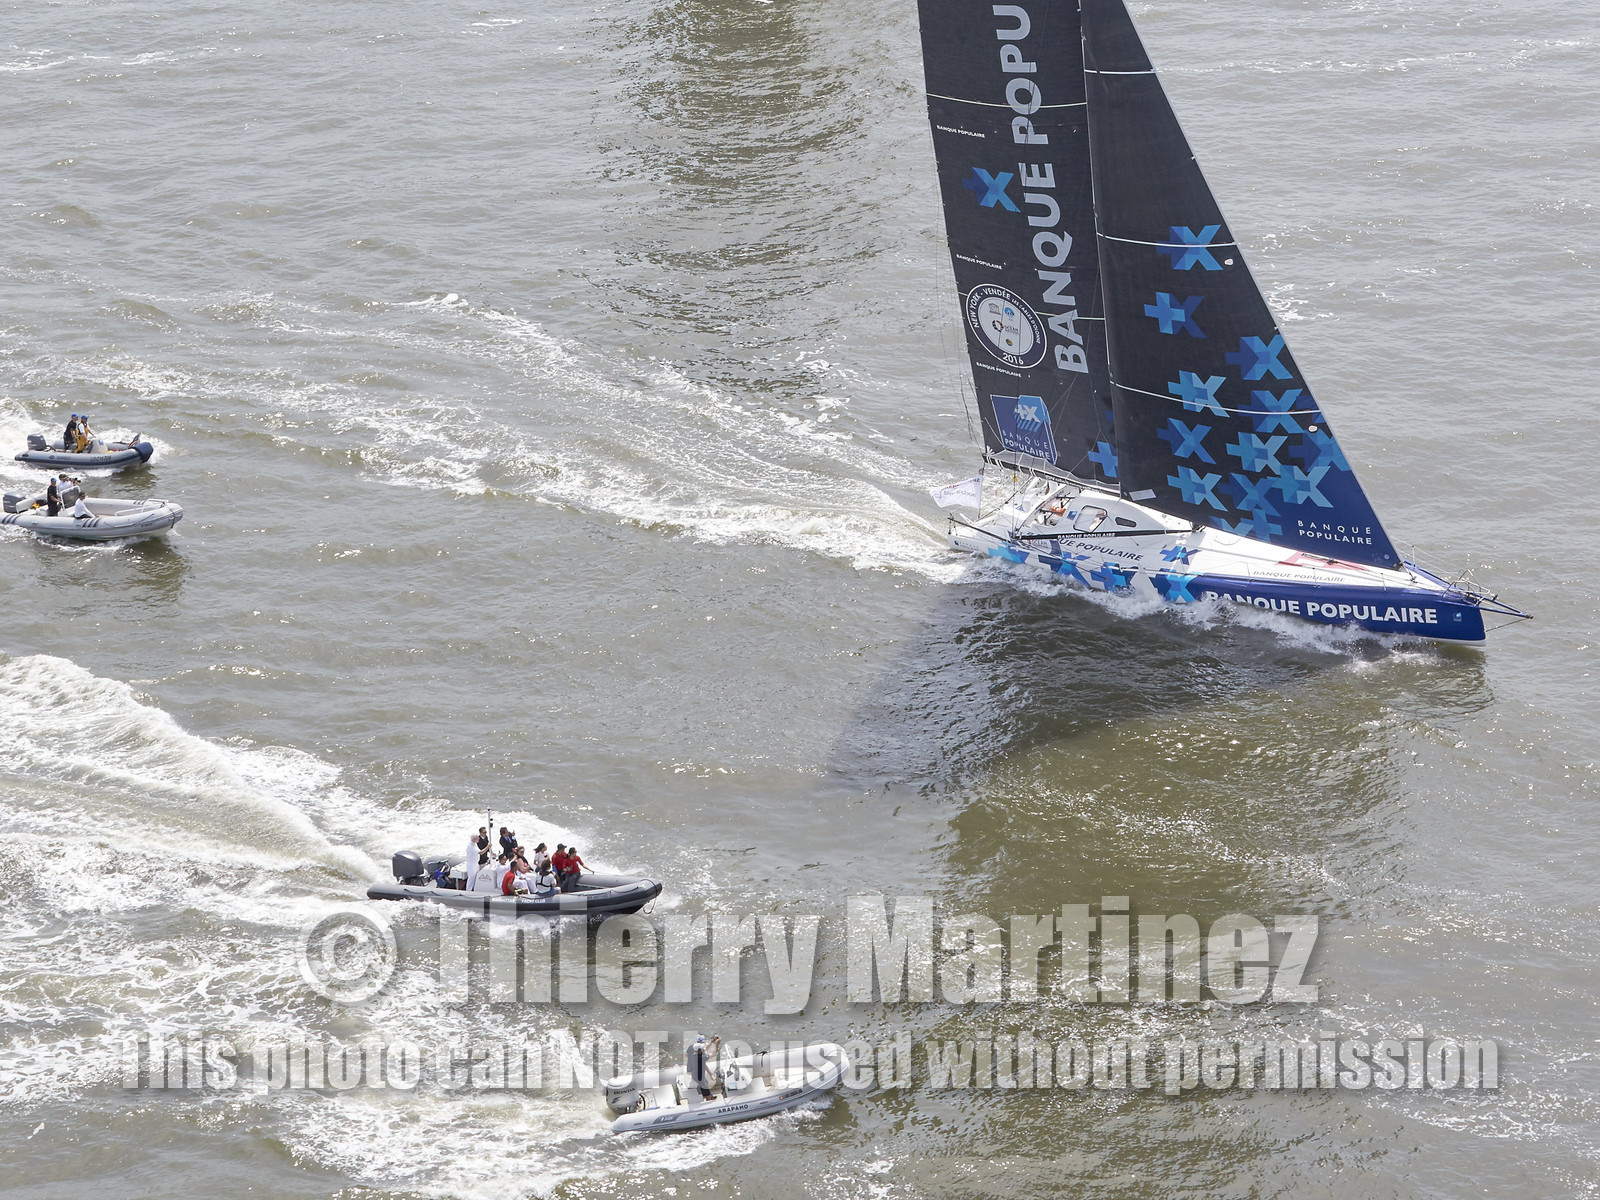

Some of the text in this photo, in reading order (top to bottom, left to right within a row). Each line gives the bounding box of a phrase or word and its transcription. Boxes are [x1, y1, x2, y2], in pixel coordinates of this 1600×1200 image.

[936, 124, 986, 138] BANQUE POPULAIRE
[976, 259, 1002, 270] POPULAIRE
[1018, 162, 1089, 374] BANQUE
[970, 292, 982, 311] YORK
[982, 288, 1011, 300] VENDÉE
[970, 310, 980, 328] NEW
[1002, 352, 1024, 365] 2016
[996, 366, 1022, 378] POPULAIRE
[1002, 429, 1048, 450] BANQUE
[1004, 438, 1051, 460] POPULAIRE
[1298, 520, 1372, 535] BANQUE
[1299, 529, 1373, 545] POPULAIRE
[1076, 542, 1144, 561] POPULAIRE
[1253, 570, 1347, 582] BANQUE POPULAIRE
[1306, 601, 1438, 624] POPULAIRE
[718, 1104, 749, 1114] ARAPAHO
